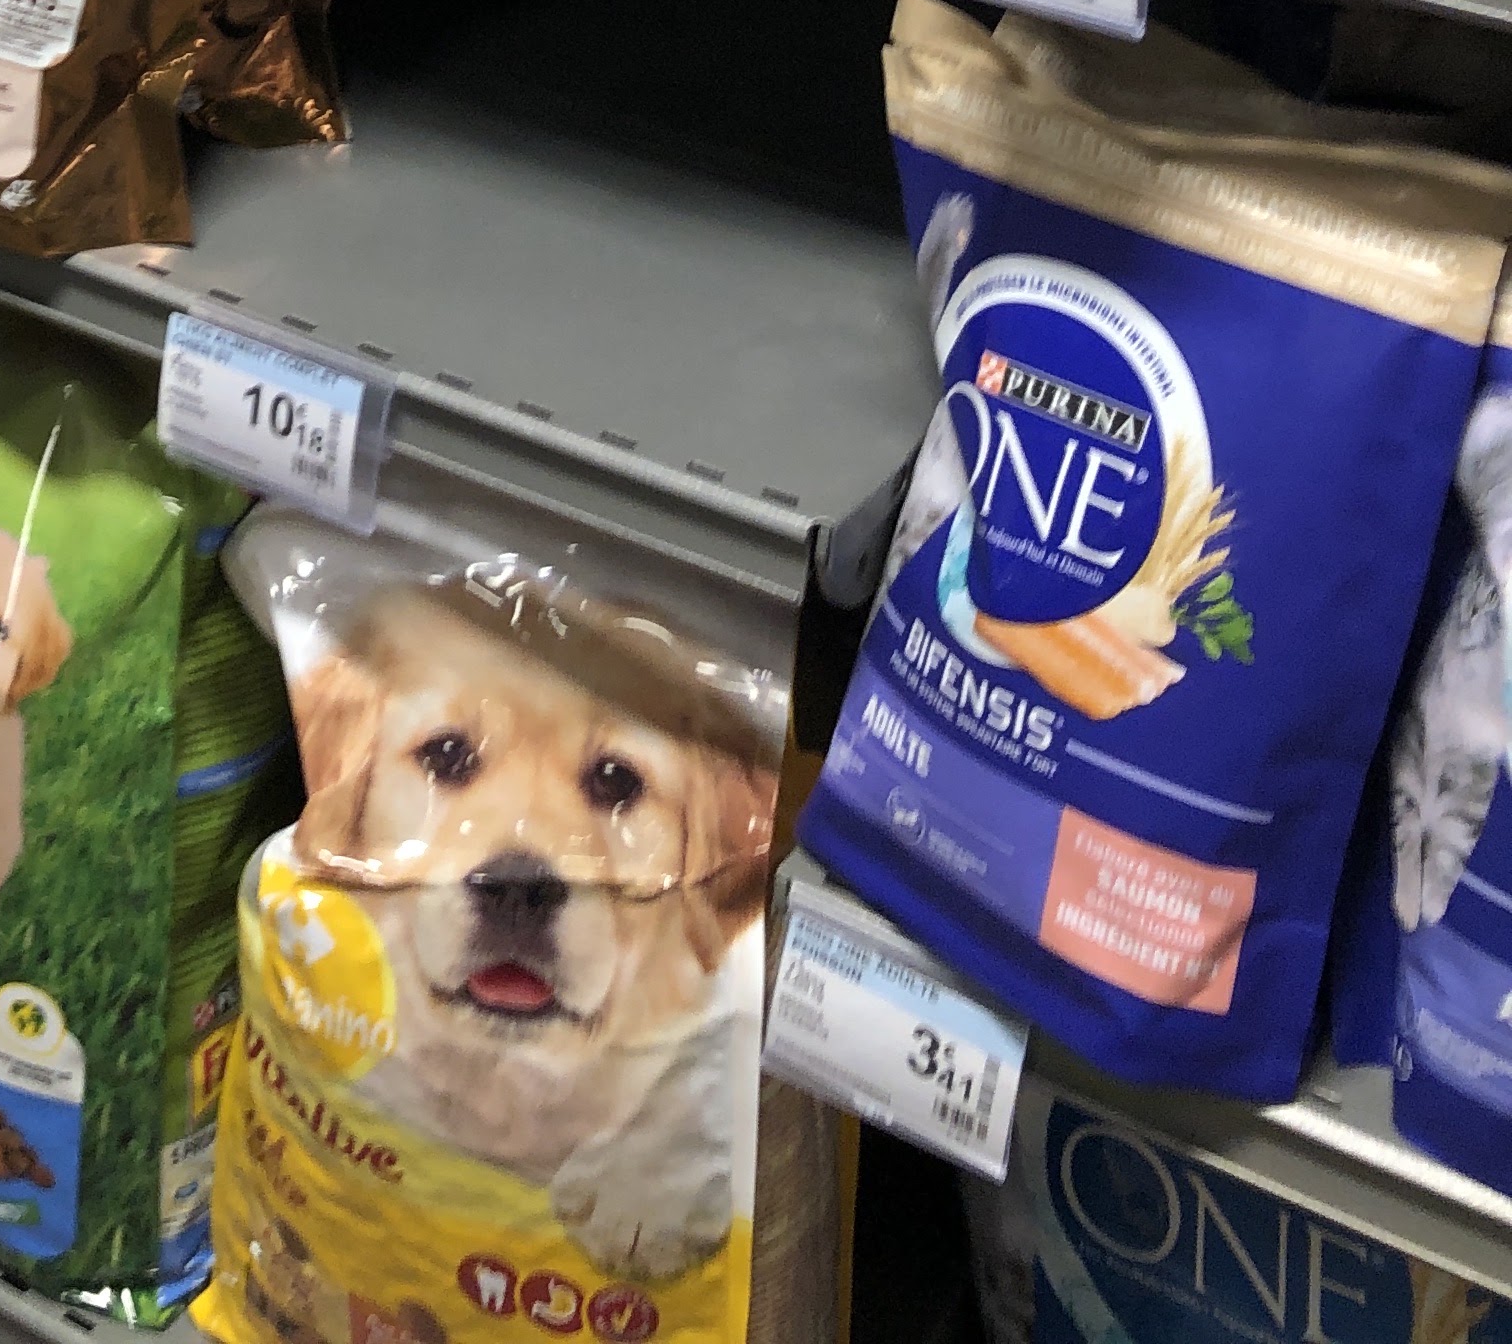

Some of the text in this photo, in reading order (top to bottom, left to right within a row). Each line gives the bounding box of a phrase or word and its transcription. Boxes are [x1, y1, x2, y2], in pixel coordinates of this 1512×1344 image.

[1002, 368, 1139, 447] PURINA
[903, 616, 1058, 753] BIFENSIS
[861, 693, 934, 780] ADULTE
